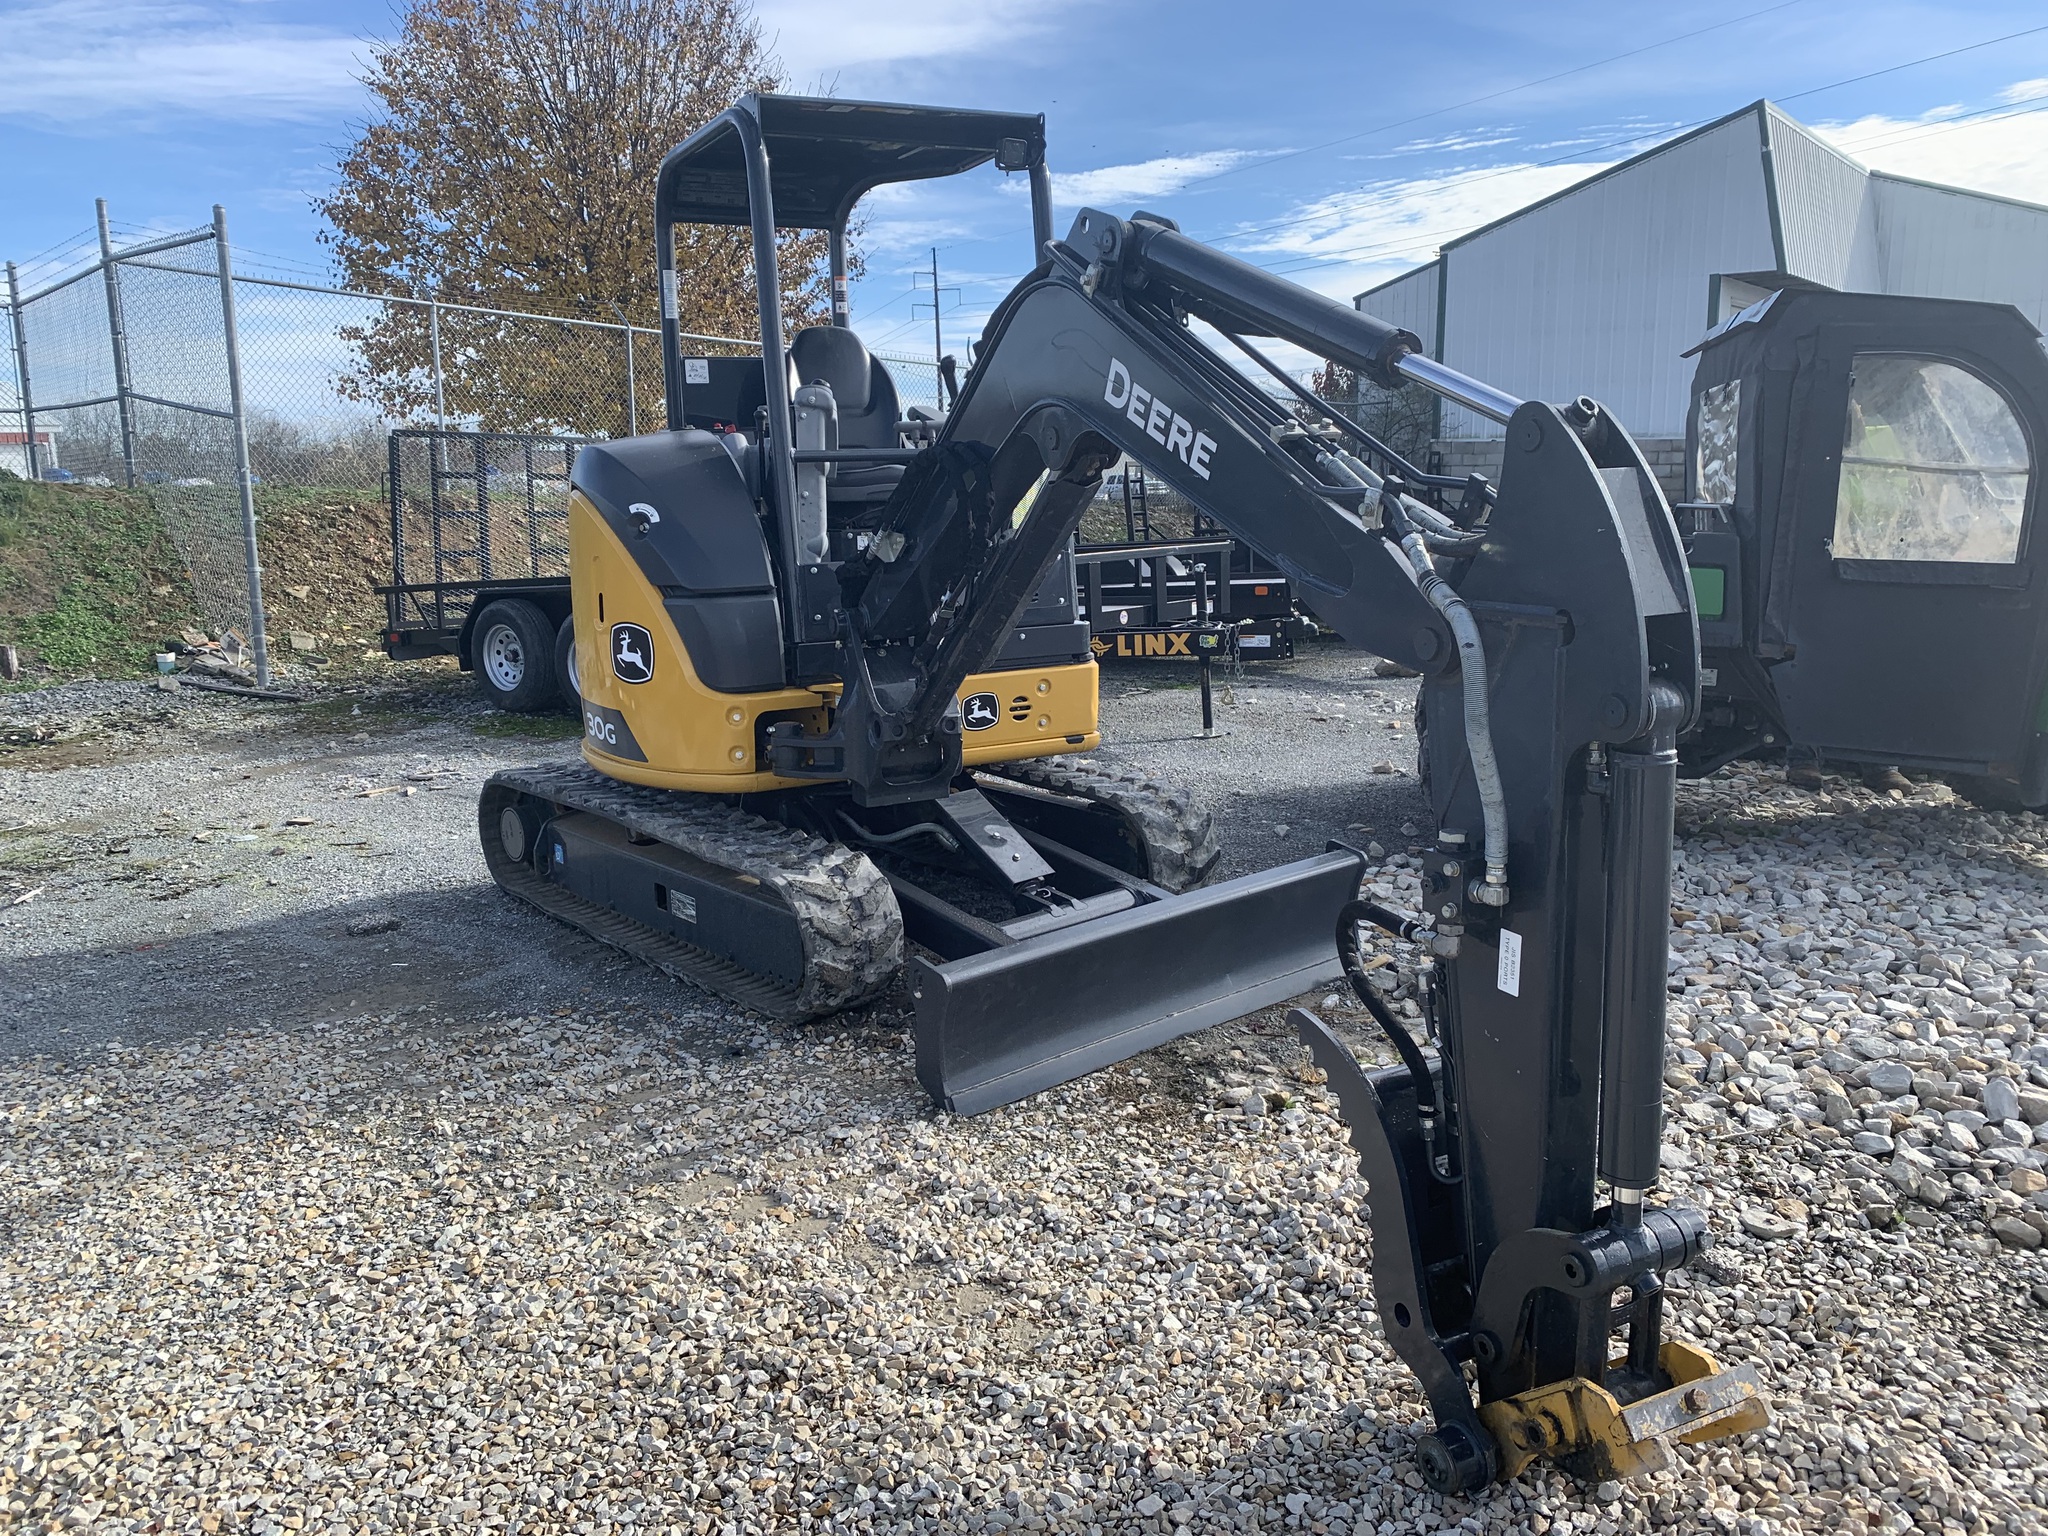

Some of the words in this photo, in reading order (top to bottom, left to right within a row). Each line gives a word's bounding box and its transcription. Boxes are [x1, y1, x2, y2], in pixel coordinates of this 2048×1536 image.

[1104, 357, 1218, 481] DEERE
[1117, 632, 1192, 656] LINX
[586, 711, 617, 745] 30G
